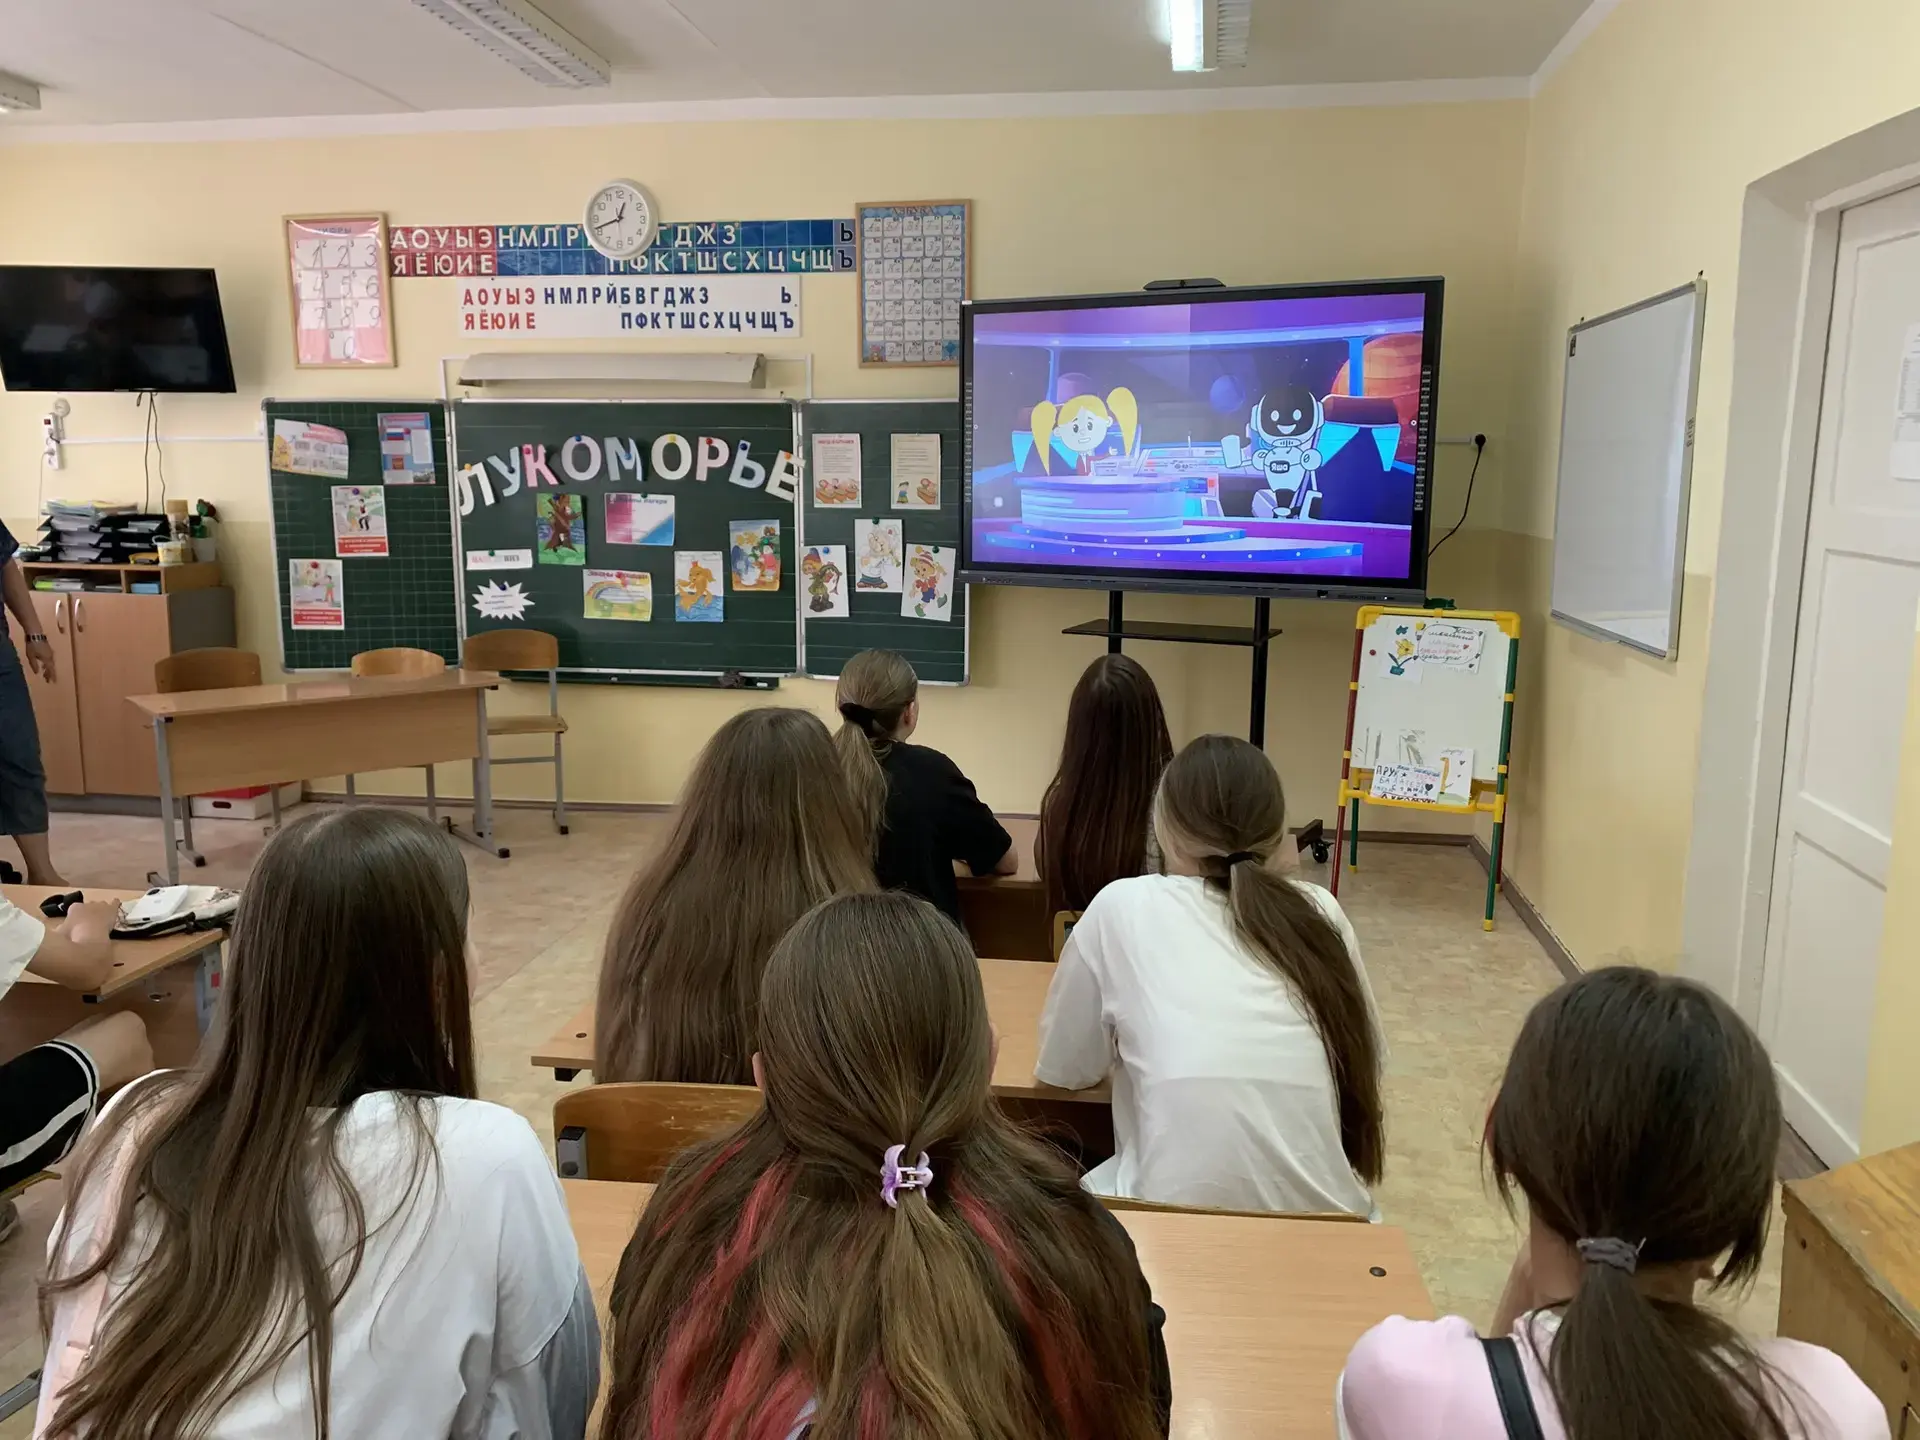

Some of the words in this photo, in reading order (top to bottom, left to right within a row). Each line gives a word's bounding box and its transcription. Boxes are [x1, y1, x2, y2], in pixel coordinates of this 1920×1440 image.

[615, 190, 625, 200] 12
[639, 215, 646, 225] 3
[365, 244, 377, 268] 3
[366, 275, 379, 298] 6
[455, 433, 806, 516] ЛУКОМОРЬЕ
[1271, 462, 1288, 471] Яша
